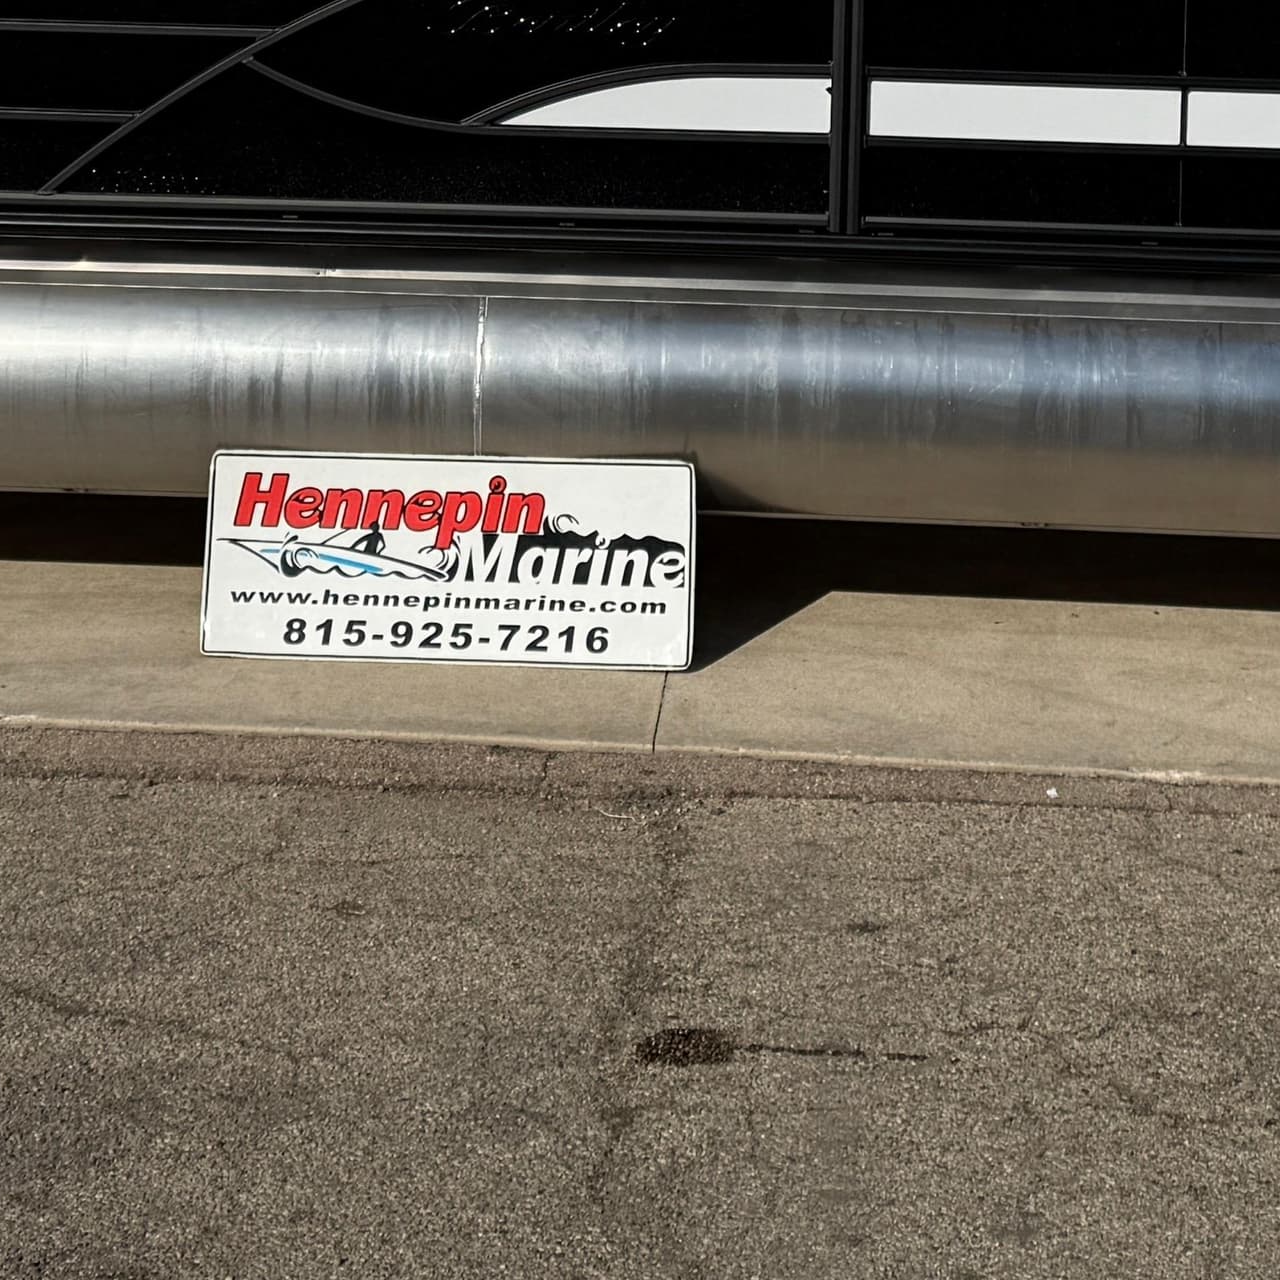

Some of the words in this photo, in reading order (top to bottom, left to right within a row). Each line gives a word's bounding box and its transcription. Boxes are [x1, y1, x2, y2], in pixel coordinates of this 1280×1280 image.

[233, 472, 546, 550] Hennepin
[454, 532, 686, 588] Marine
[230, 589, 667, 614] www.hennepinmarine.com
[283, 618, 609, 654] 815-925-7216
